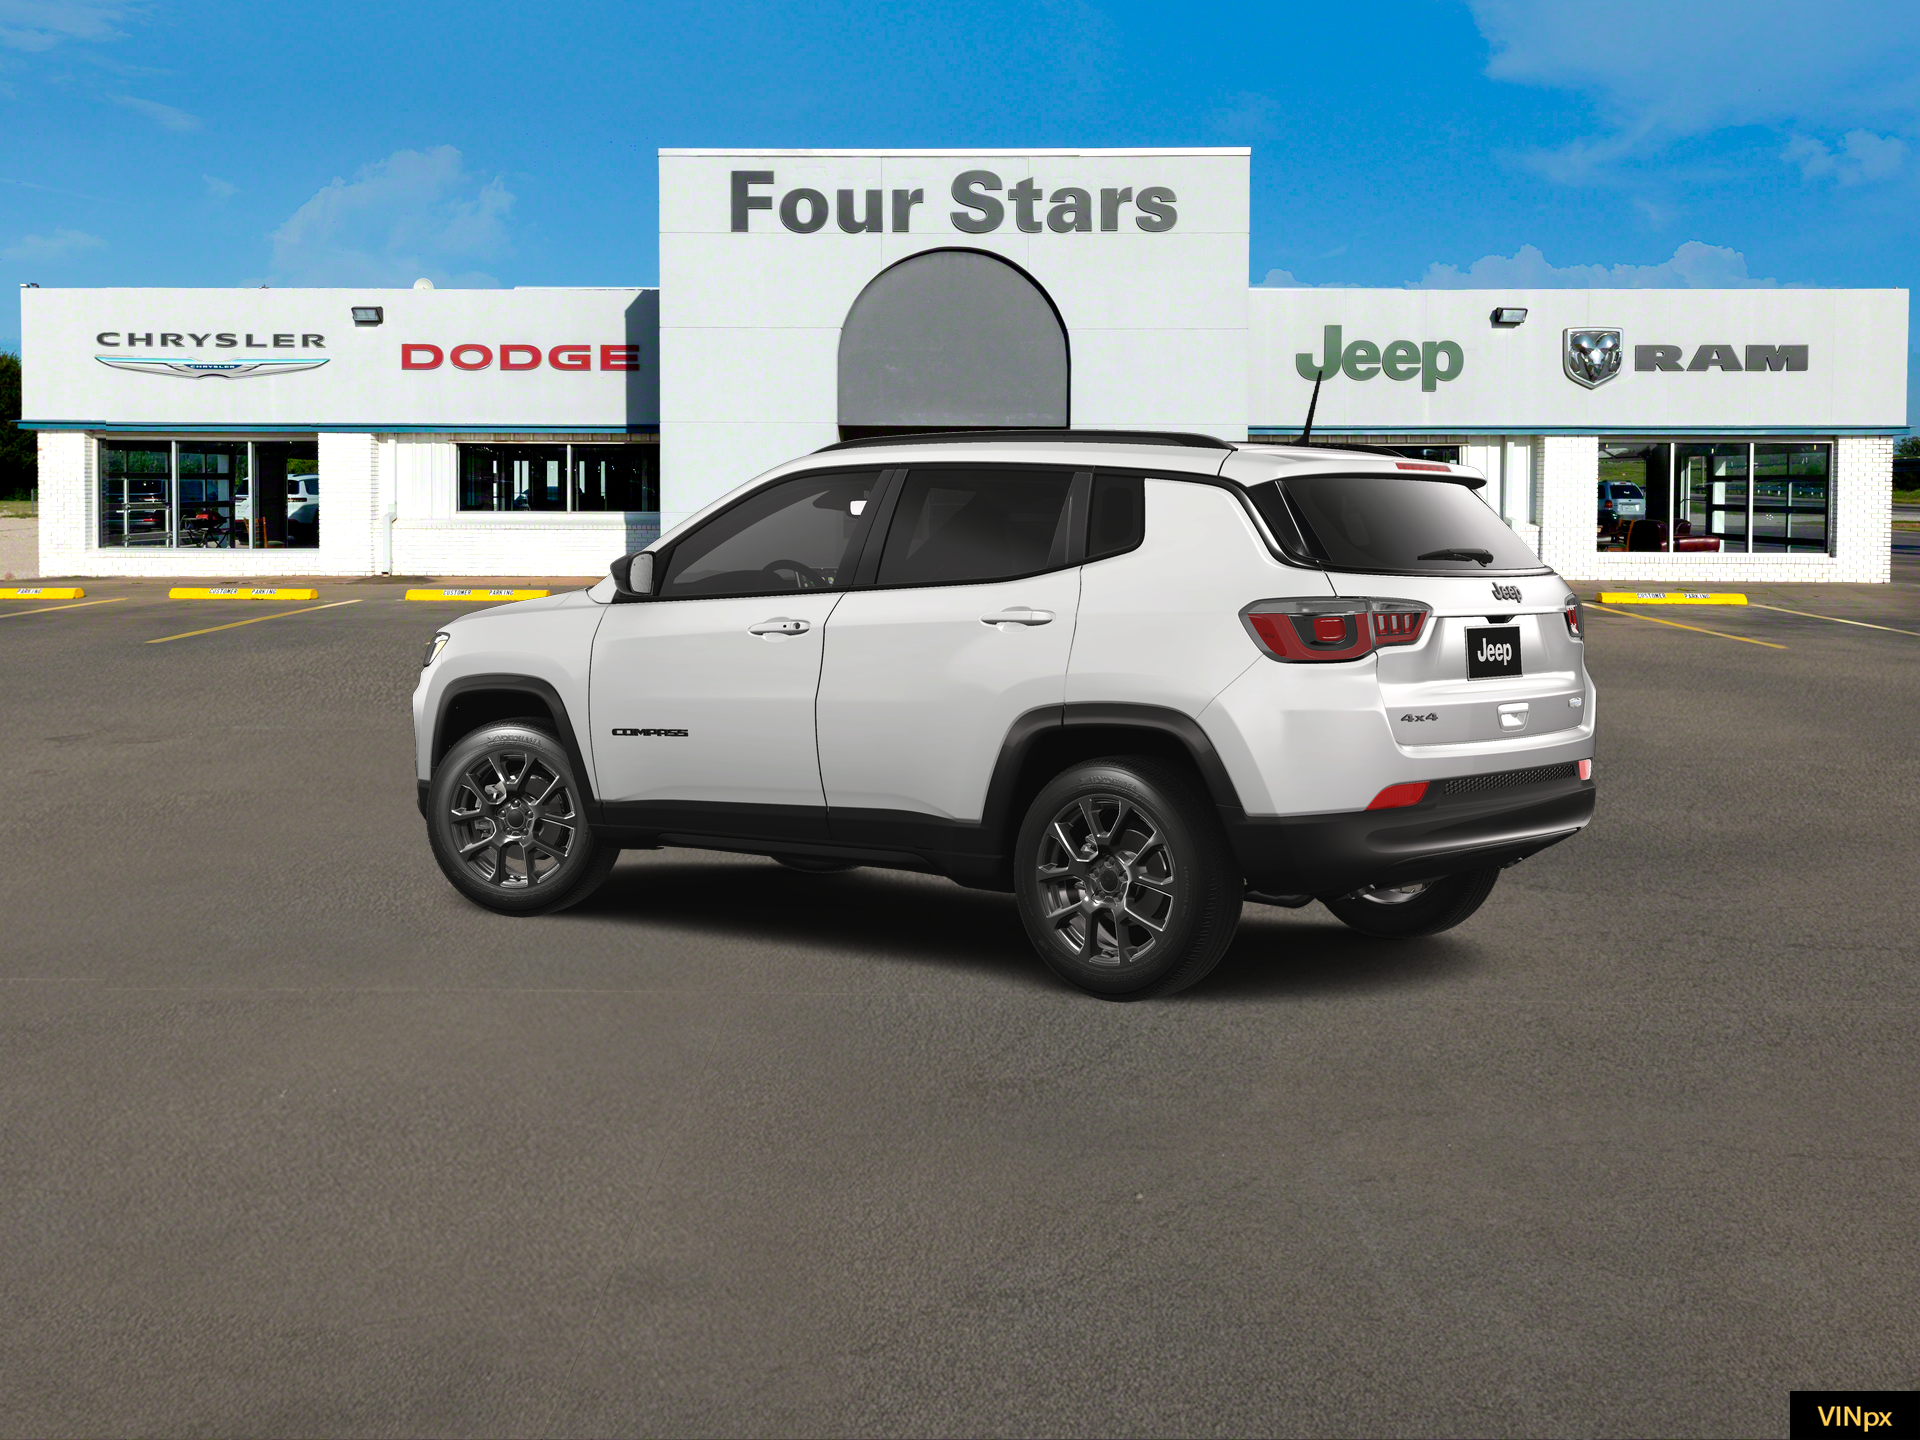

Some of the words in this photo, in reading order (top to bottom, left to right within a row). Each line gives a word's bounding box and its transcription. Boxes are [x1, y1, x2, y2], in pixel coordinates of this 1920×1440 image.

[730, 170, 925, 234] Four
[949, 169, 1178, 234] Stars
[96, 331, 327, 349] CHRYSLER
[401, 343, 640, 371] DODGE
[1295, 324, 1465, 392] Jeep
[1634, 344, 1809, 372] RAM
[1491, 582, 1522, 604] Jeep
[1477, 637, 1512, 666] Jeep
[1400, 711, 1439, 723] 4x4
[611, 728, 689, 737] COMPASS
